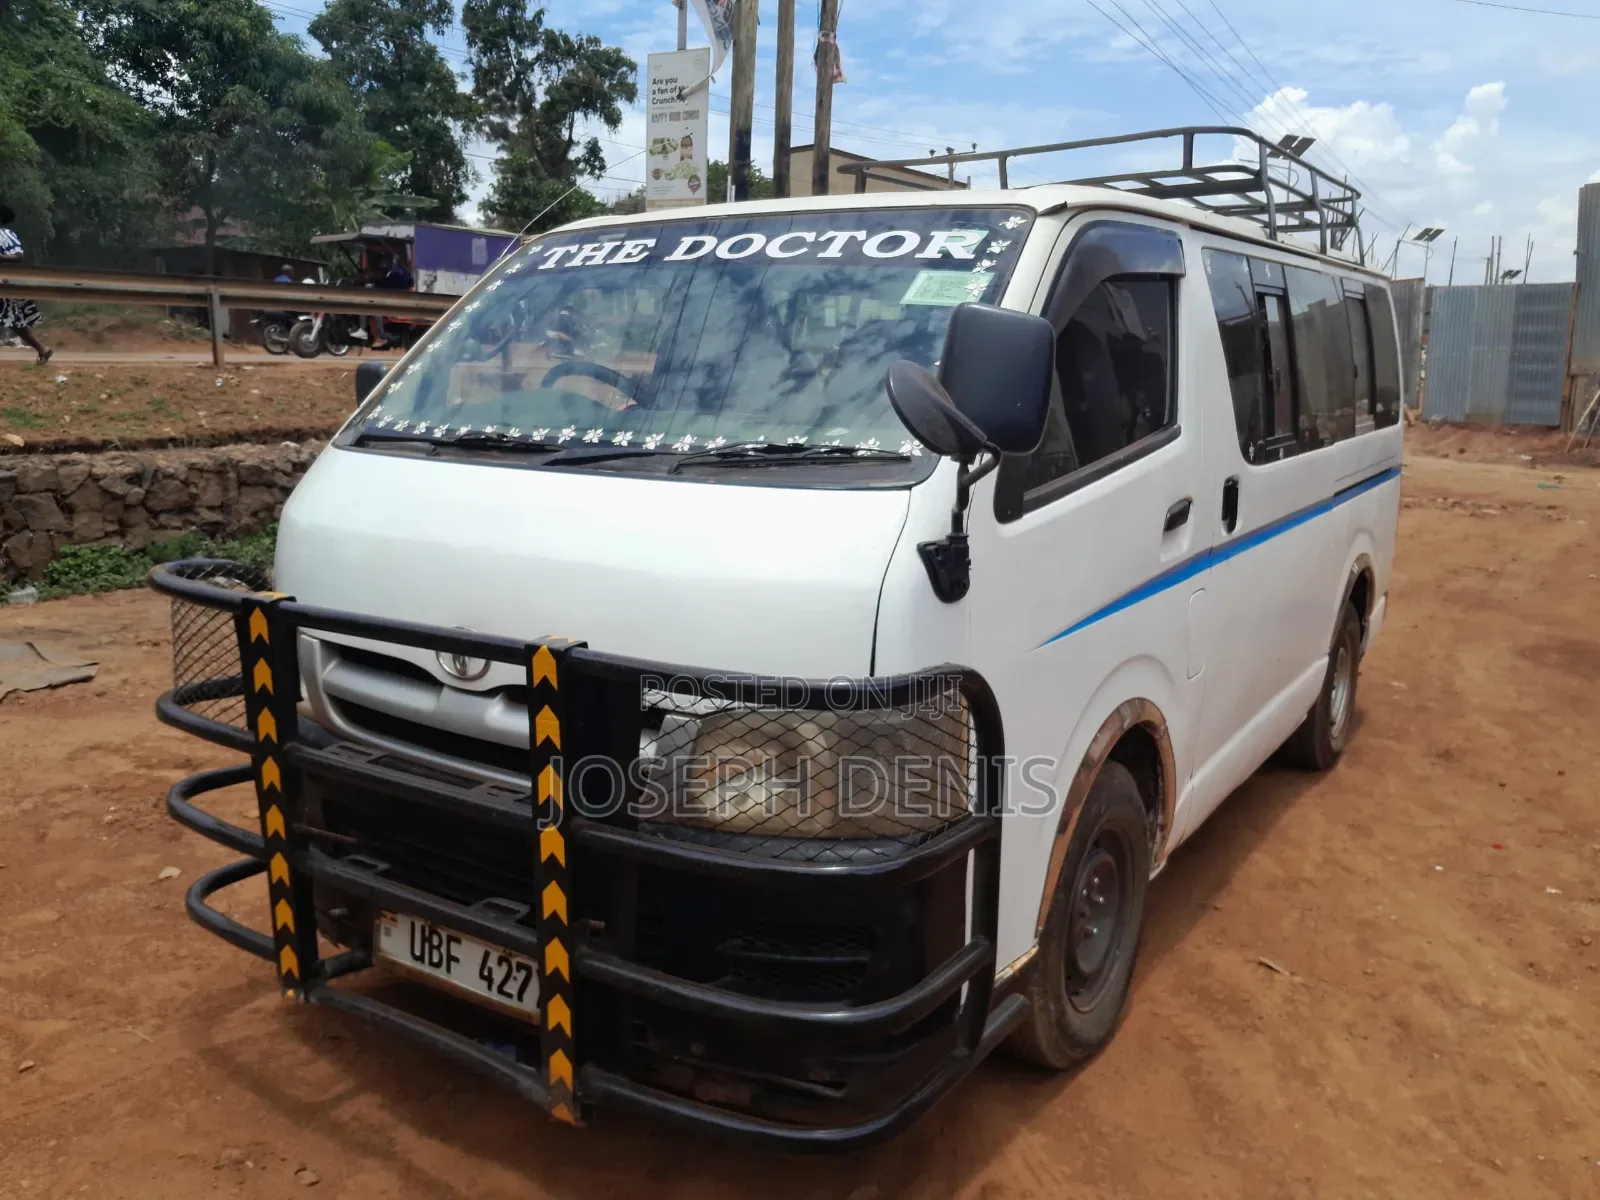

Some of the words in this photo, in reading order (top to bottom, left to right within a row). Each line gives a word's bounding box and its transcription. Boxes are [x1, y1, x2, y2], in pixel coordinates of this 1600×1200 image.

[652, 78, 664, 86] Are
[665, 77, 678, 87] you
[657, 87, 669, 95] fan
[670, 85, 678, 94] of
[537, 237, 656, 271] THE
[663, 229, 982, 262] DOCTOR
[409, 920, 463, 975] UBF
